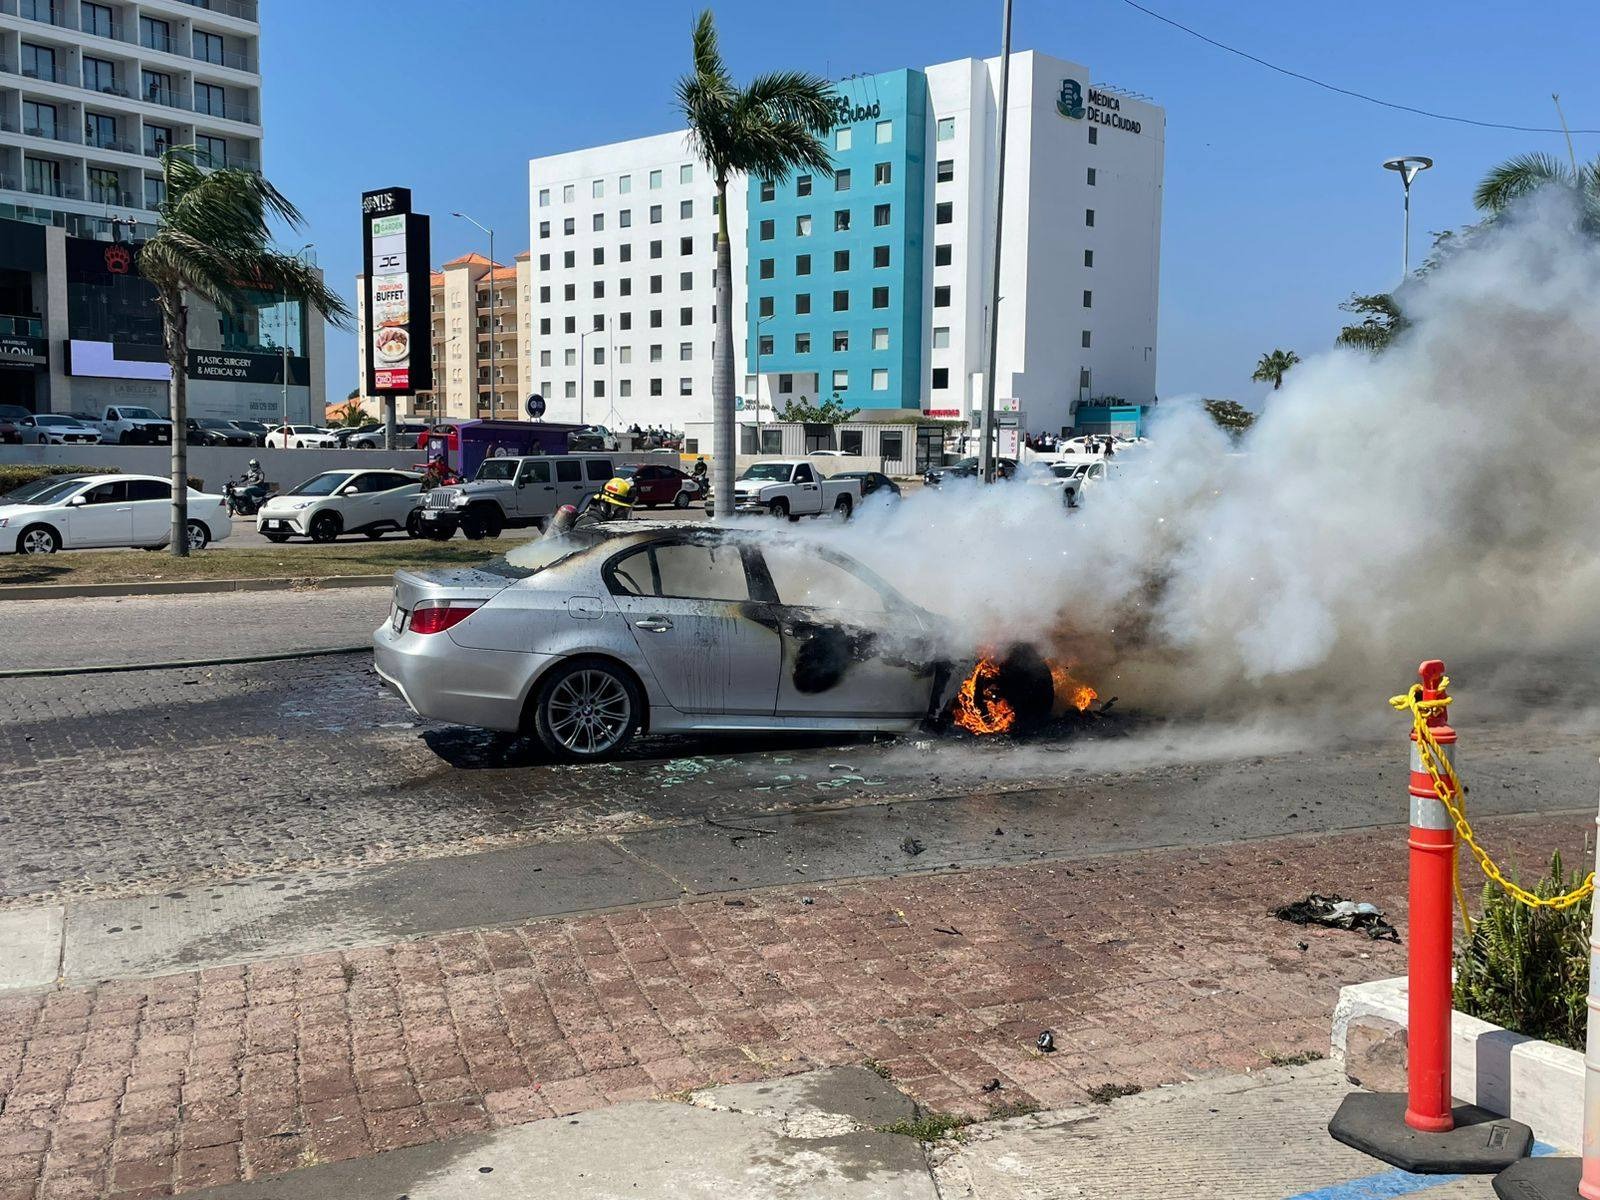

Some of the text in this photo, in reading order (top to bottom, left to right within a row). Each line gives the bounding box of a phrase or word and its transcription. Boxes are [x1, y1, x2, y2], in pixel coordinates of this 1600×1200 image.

[839, 103, 881, 125] CIUDAD
[1087, 106, 1100, 123] DE
[1101, 111, 1111, 127] LA
[380, 221, 403, 232] GARDEN
[376, 290, 404, 301] BUFFET
[197, 355, 252, 367] PLASTIC SURGERY
[197, 367, 248, 377] & MEDICAL SPA
